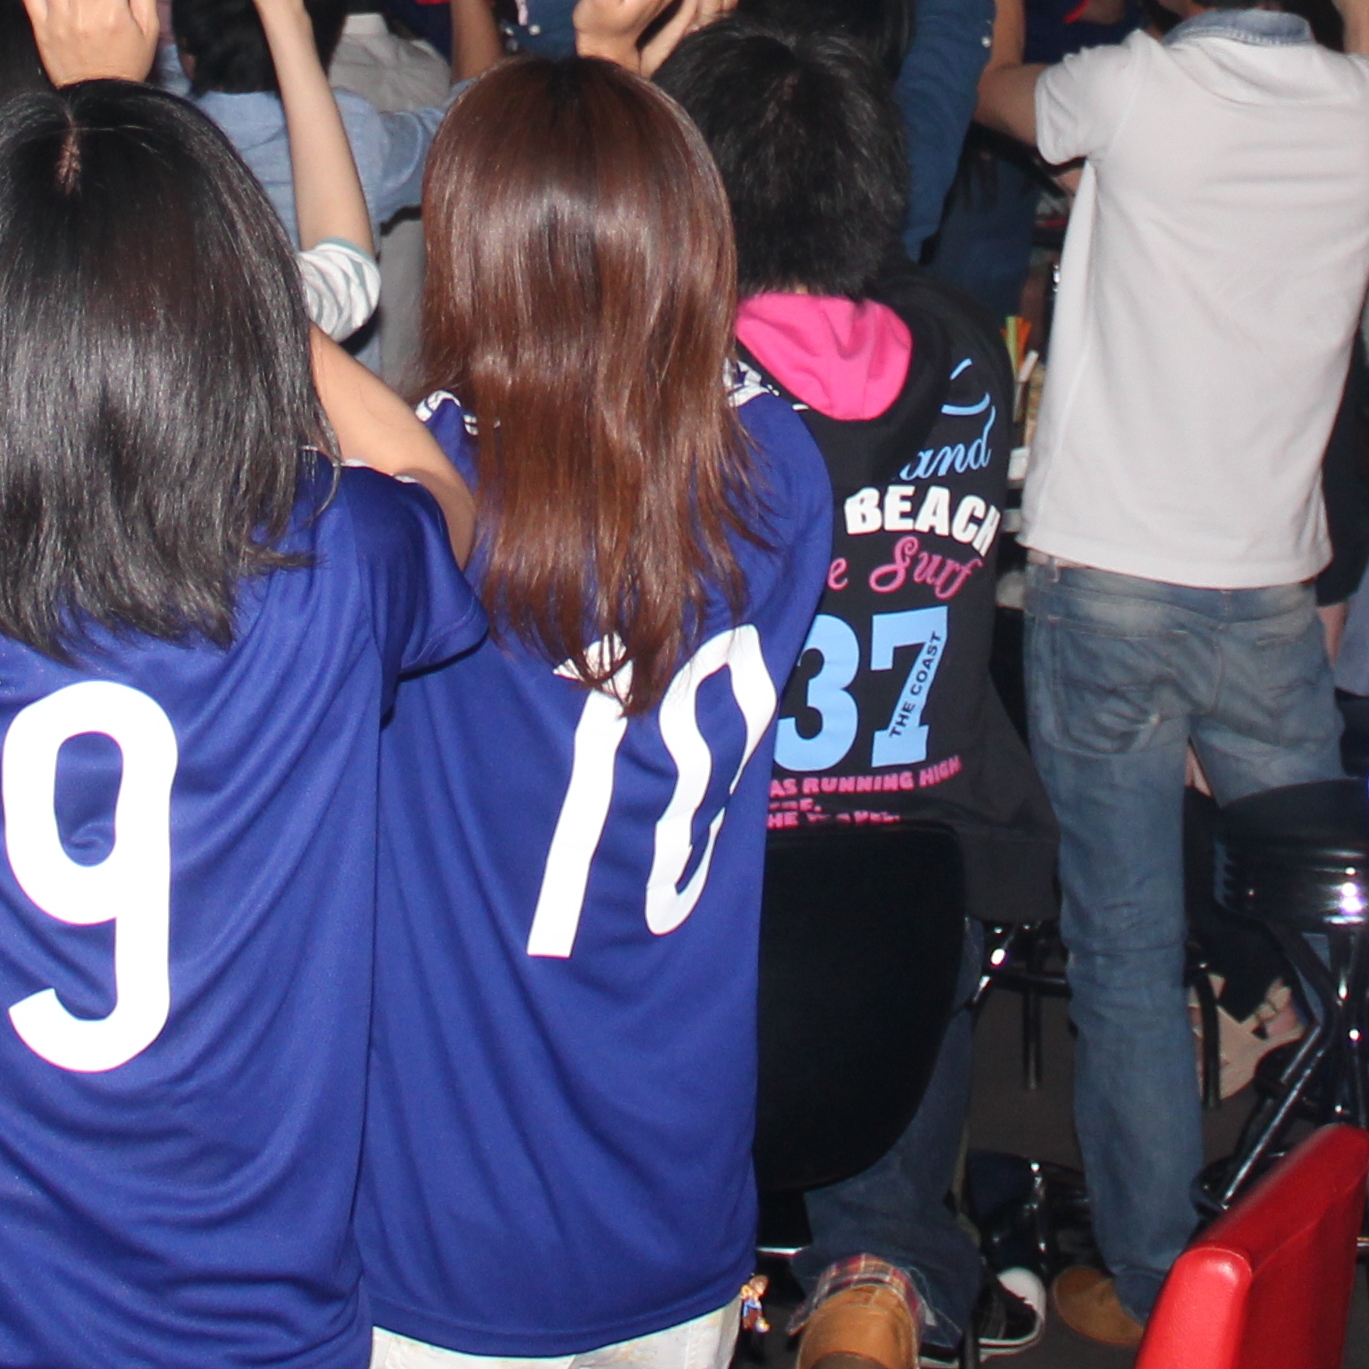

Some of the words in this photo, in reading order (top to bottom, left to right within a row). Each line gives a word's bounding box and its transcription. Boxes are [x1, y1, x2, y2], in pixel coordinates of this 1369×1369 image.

[844, 484, 1001, 558] BEACH
[869, 535, 984, 600] Surf
[773, 605, 948, 772] 37
[889, 702, 917, 739] THE
[910, 631, 942, 697] COAST
[527, 623, 777, 958] 10
[802, 771, 914, 796] RUNNING
[919, 755, 962, 787] HIGH
[0, 679, 178, 1074] 9
